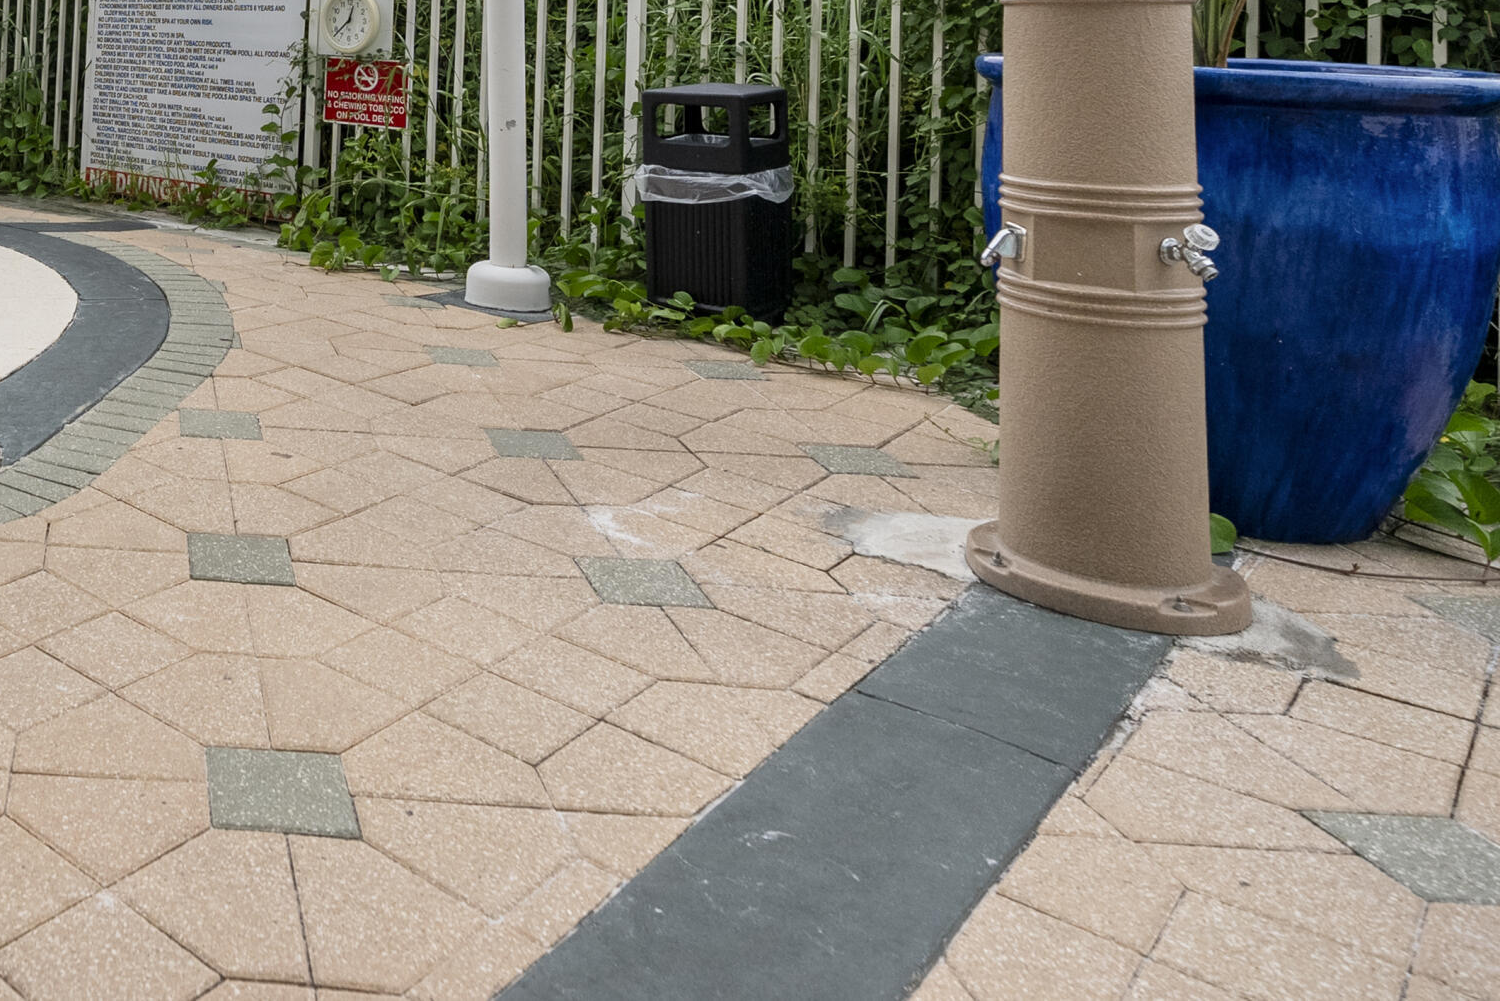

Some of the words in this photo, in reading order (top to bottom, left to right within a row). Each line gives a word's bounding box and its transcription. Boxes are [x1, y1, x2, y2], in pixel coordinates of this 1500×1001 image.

[334, 101, 367, 110] CHEWING
[350, 112, 370, 121] POOL
[116, 172, 170, 200] DIVING
